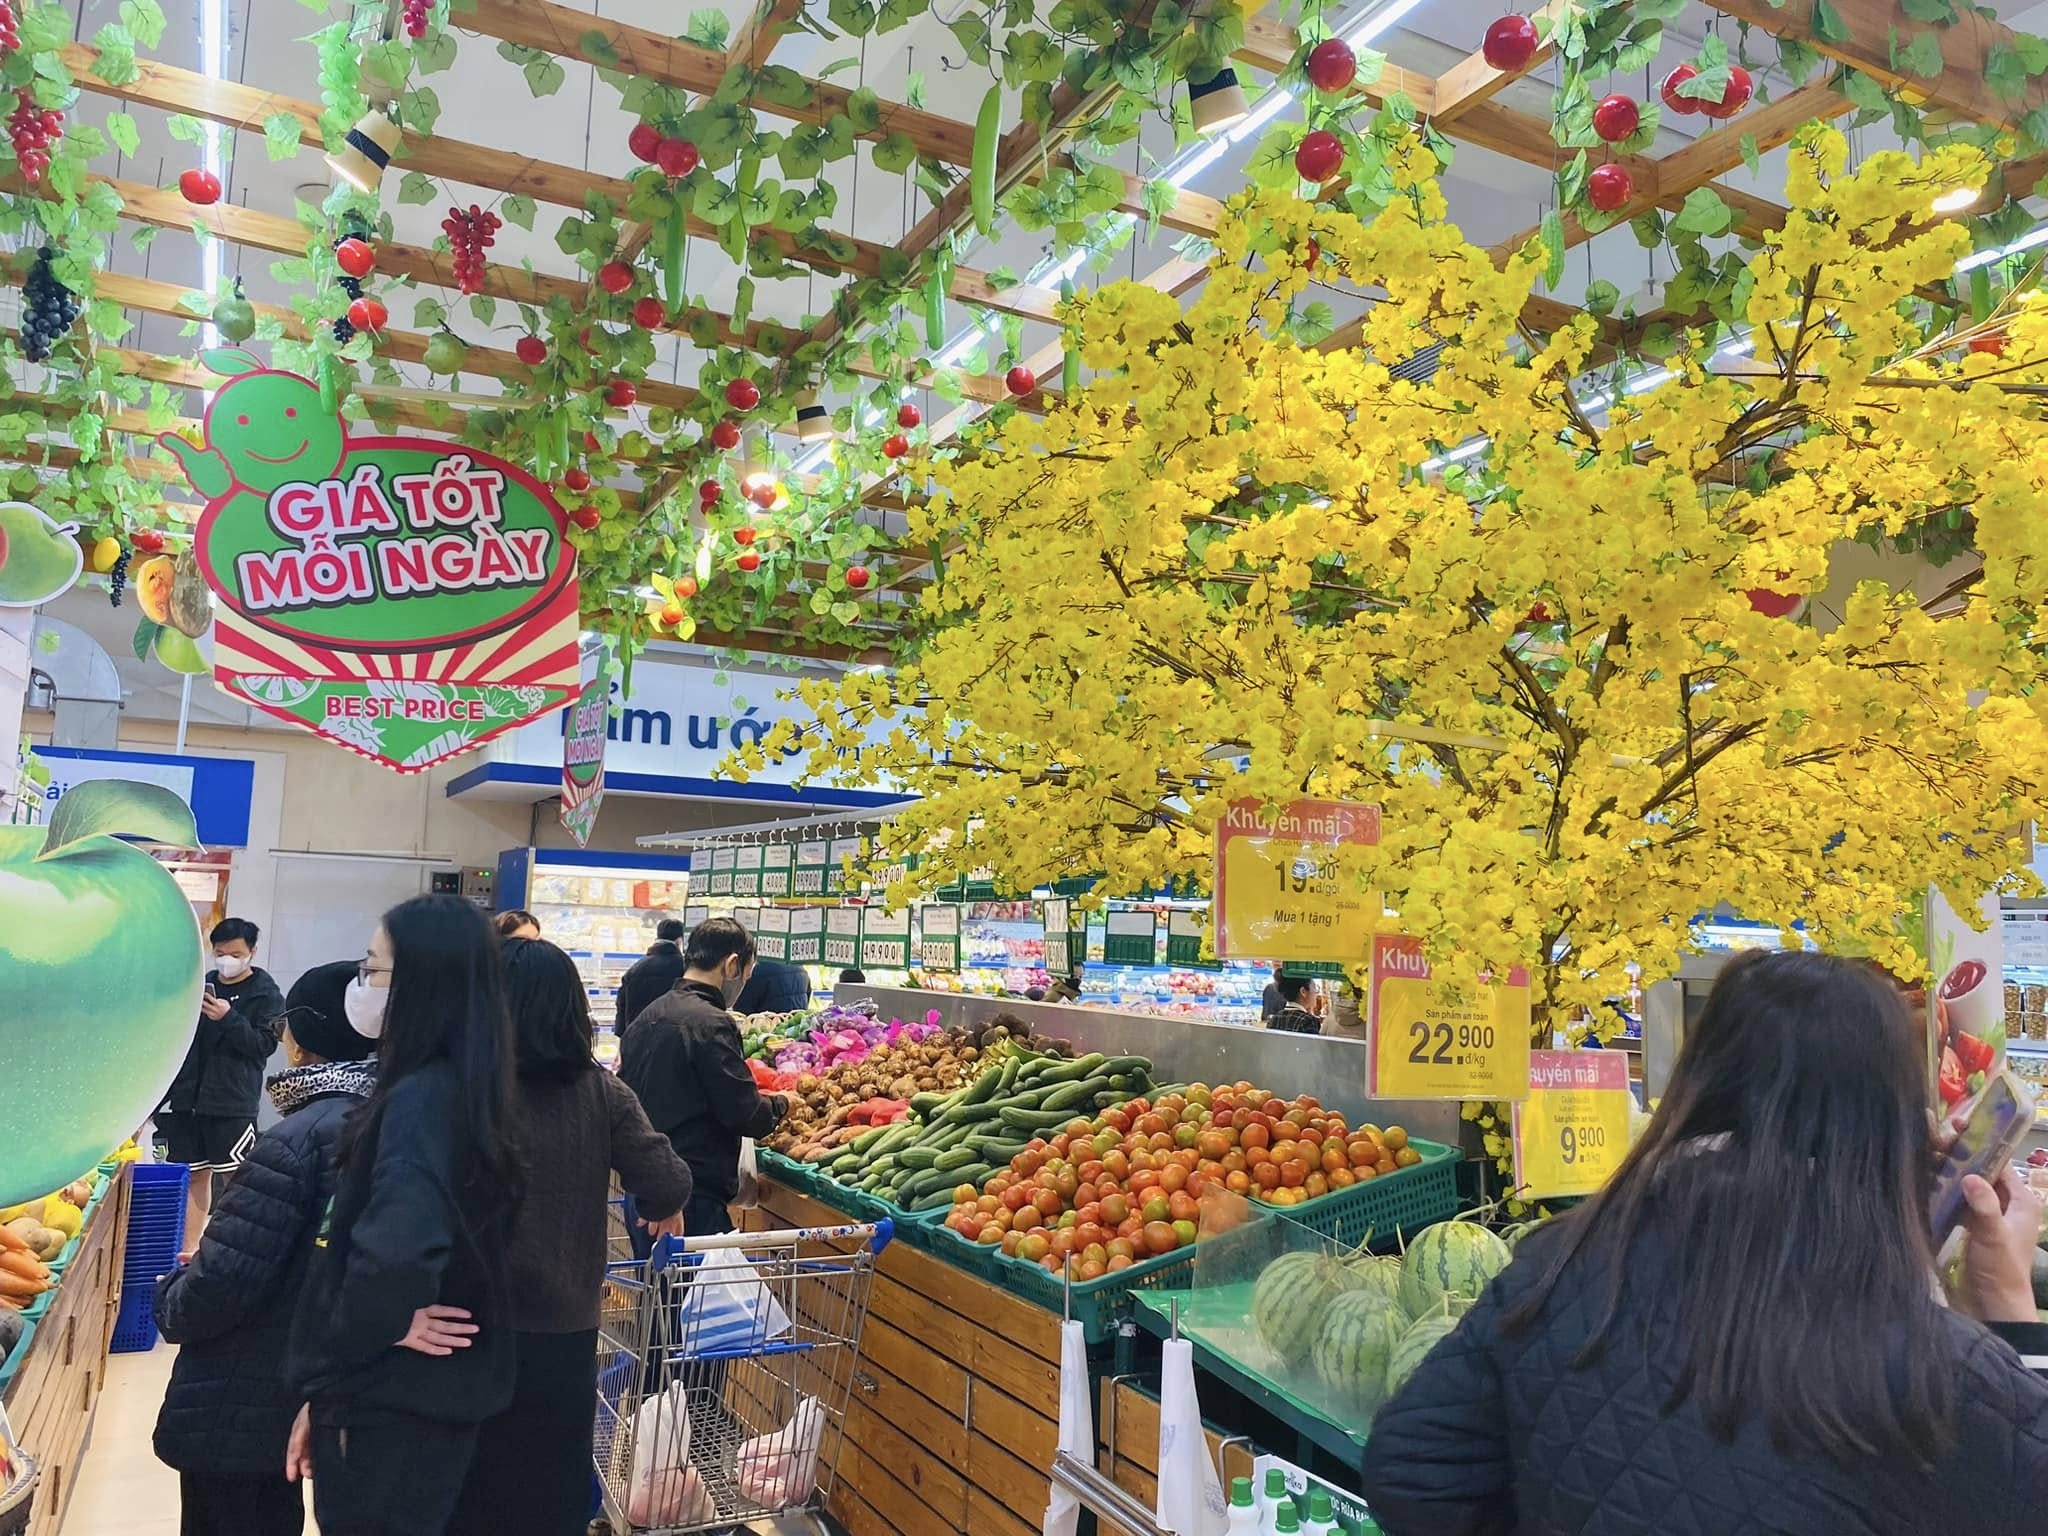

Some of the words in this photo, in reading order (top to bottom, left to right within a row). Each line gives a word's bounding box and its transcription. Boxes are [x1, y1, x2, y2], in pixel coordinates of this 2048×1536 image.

[273, 469, 394, 535] GIÁ
[398, 459, 500, 524] TỐT
[242, 530, 370, 604] MỖI
[382, 525, 546, 590] NGÀY
[326, 695, 395, 718] BEST
[404, 698, 485, 720] PRICE
[1307, 815, 1340, 835] mãi
[1273, 910, 1297, 923] Mua
[1300, 911, 1305, 923] 1
[1308, 911, 1332, 927] tặng
[1335, 913, 1341, 924] 1
[1381, 947, 1431, 977] Khuy
[1465, 1054, 1486, 1067] đ/kg
[1575, 1063, 1600, 1083] mãi
